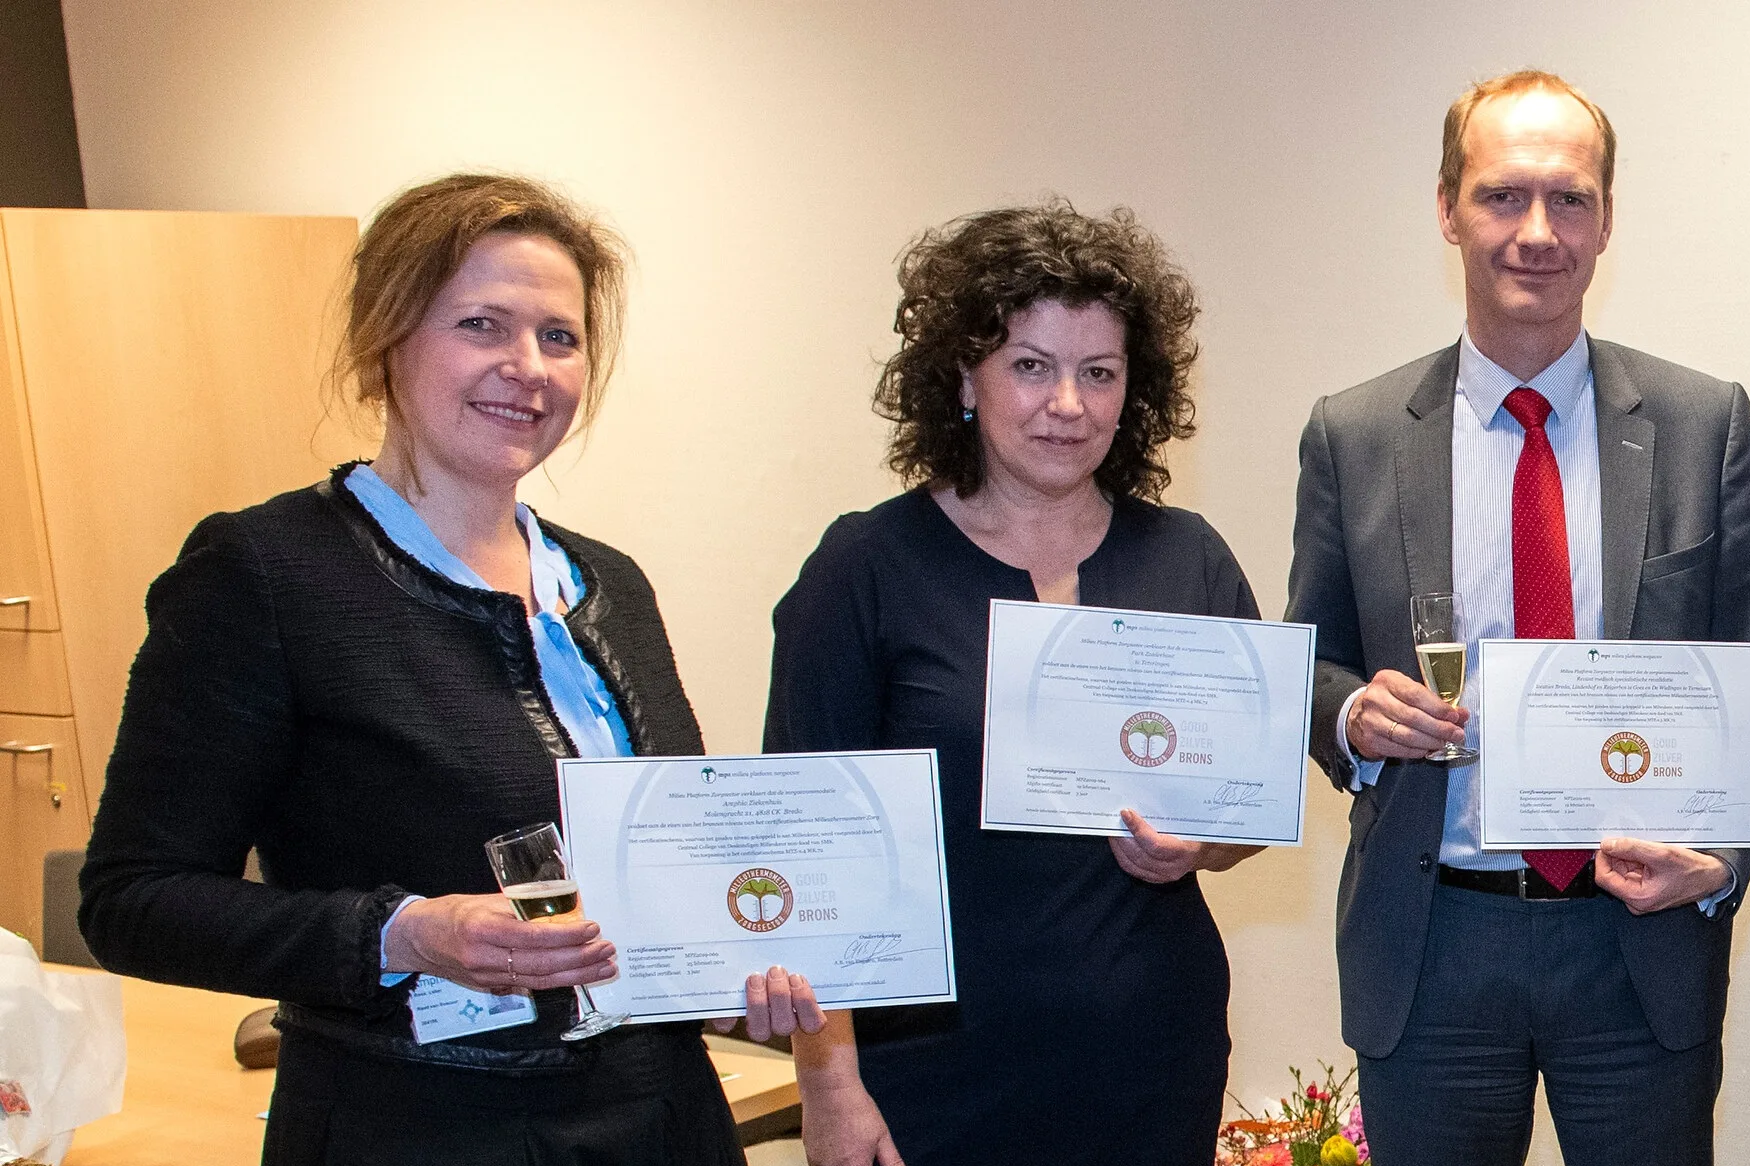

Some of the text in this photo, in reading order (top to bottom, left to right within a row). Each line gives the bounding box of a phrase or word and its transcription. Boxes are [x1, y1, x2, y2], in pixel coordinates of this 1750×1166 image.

[1123, 712, 1176, 737] MILIEUTHERMOMETER
[1604, 732, 1648, 753] MILIEUTHERMOMETER
[1128, 752, 1168, 766] ZORGSECTOR
[1179, 752, 1213, 766] BRONS
[1608, 771, 1643, 782] ZORGSECTOR
[1653, 766, 1683, 777] BRONS
[730, 868, 790, 894] MILIEUTHERMOMETER
[798, 908, 838, 922] BRONS
[738, 915, 785, 932] ZORGSECTOR
